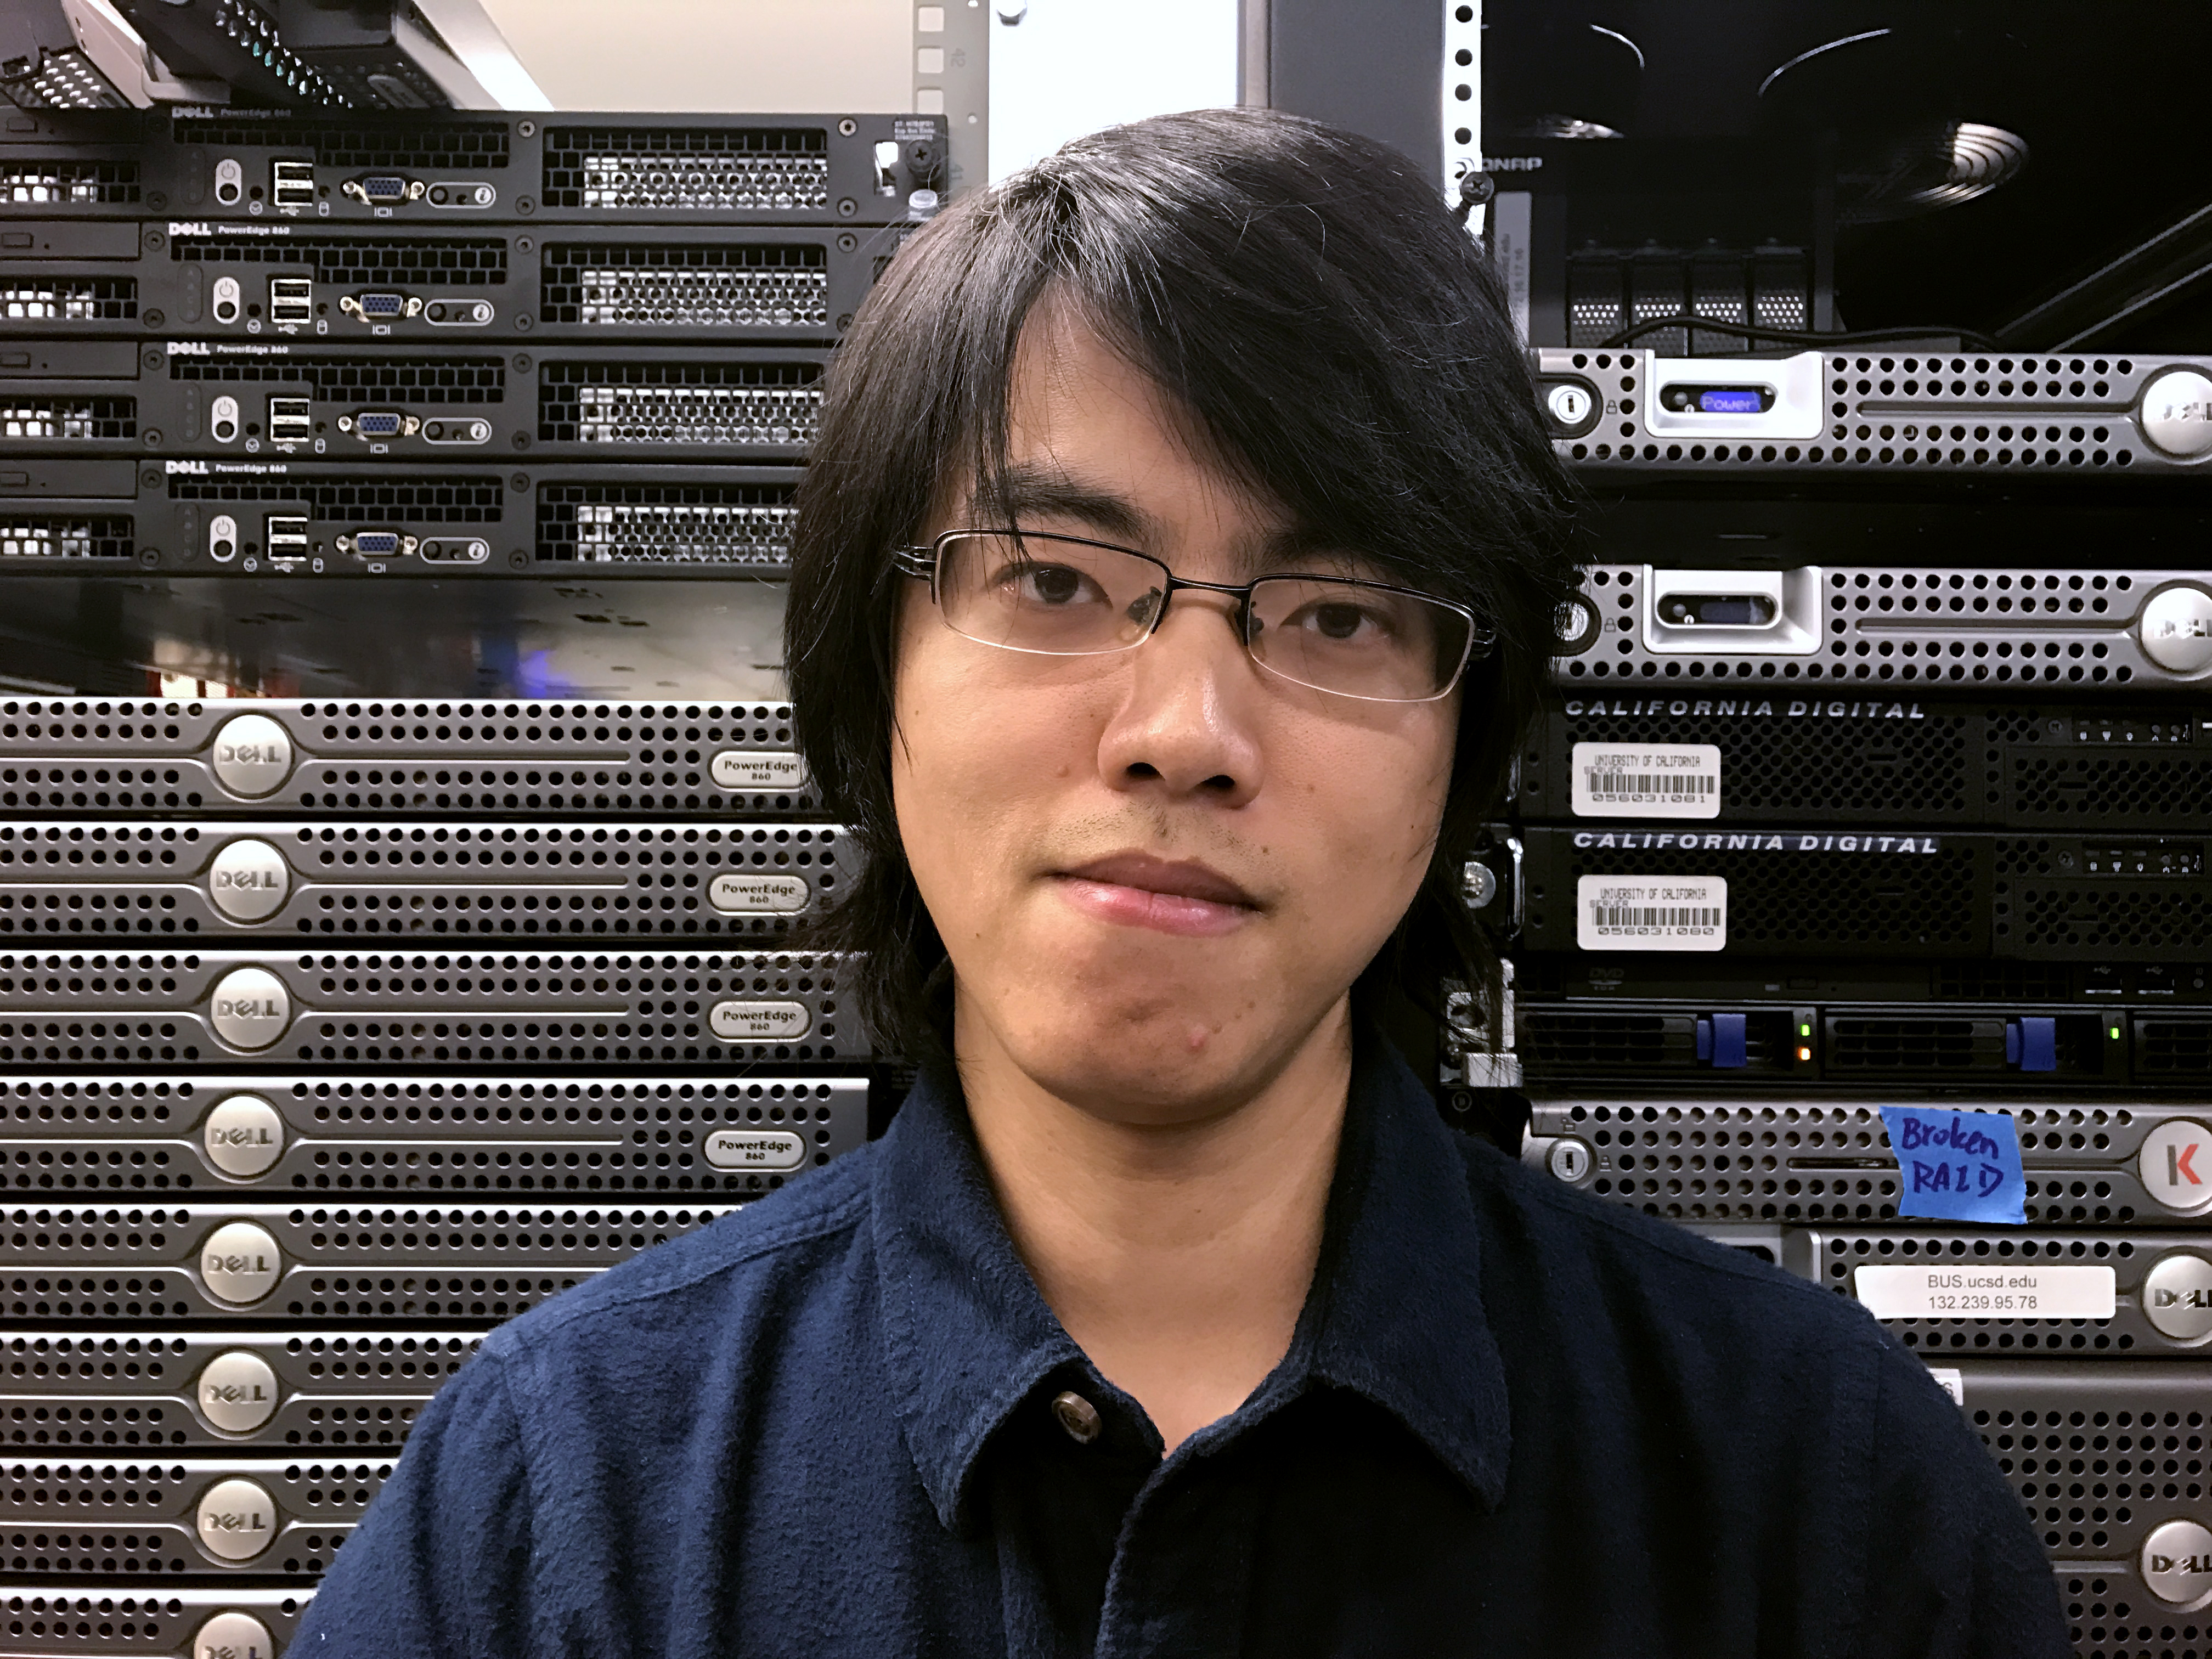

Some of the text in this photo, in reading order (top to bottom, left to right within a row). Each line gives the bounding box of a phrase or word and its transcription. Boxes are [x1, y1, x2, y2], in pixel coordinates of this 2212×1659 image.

[168, 222, 212, 236] DELL
[218, 225, 270, 236] PowerEdge
[167, 342, 211, 356] DELL
[217, 345, 268, 356] PowerEdge
[166, 460, 209, 475] DELL
[216, 464, 267, 475] PowerEdge
[1566, 700, 1924, 719] CALIFORNIA DIGITAL
[219, 744, 281, 765] DELL
[1595, 754, 1700, 768] UNIVERSITY OF CALIFORNIA
[725, 760, 797, 774] PowerEdge
[752, 772, 771, 781] 860
[1592, 794, 1705, 803] 056031081
[1574, 832, 1937, 854] CALIFORNIA DIGITAL
[216, 871, 278, 890] DELL
[723, 883, 795, 896] PowerEdge
[1600, 888, 1707, 900] UNIVERSITY OF CALIFORNIA
[749, 895, 769, 904] 860
[1598, 927, 1714, 935] 056031080
[217, 999, 280, 1019] DELL
[723, 1010, 796, 1023] PowerEdge
[211, 1127, 273, 1148] DELL
[1902, 1116, 1999, 1159] Broken
[718, 1139, 792, 1153] PowerEdge
[745, 1152, 765, 1160] 860
[2166, 1143, 2203, 1186] K
[1912, 1160, 2004, 1198] RAID
[207, 1254, 272, 1274] DELL
[1928, 1274, 2037, 1288] BUS.ucsd.edu
[1929, 1295, 2037, 1310] 132.239.95.78
[204, 1385, 268, 1404] DELL
[204, 1513, 267, 1532] DELL
